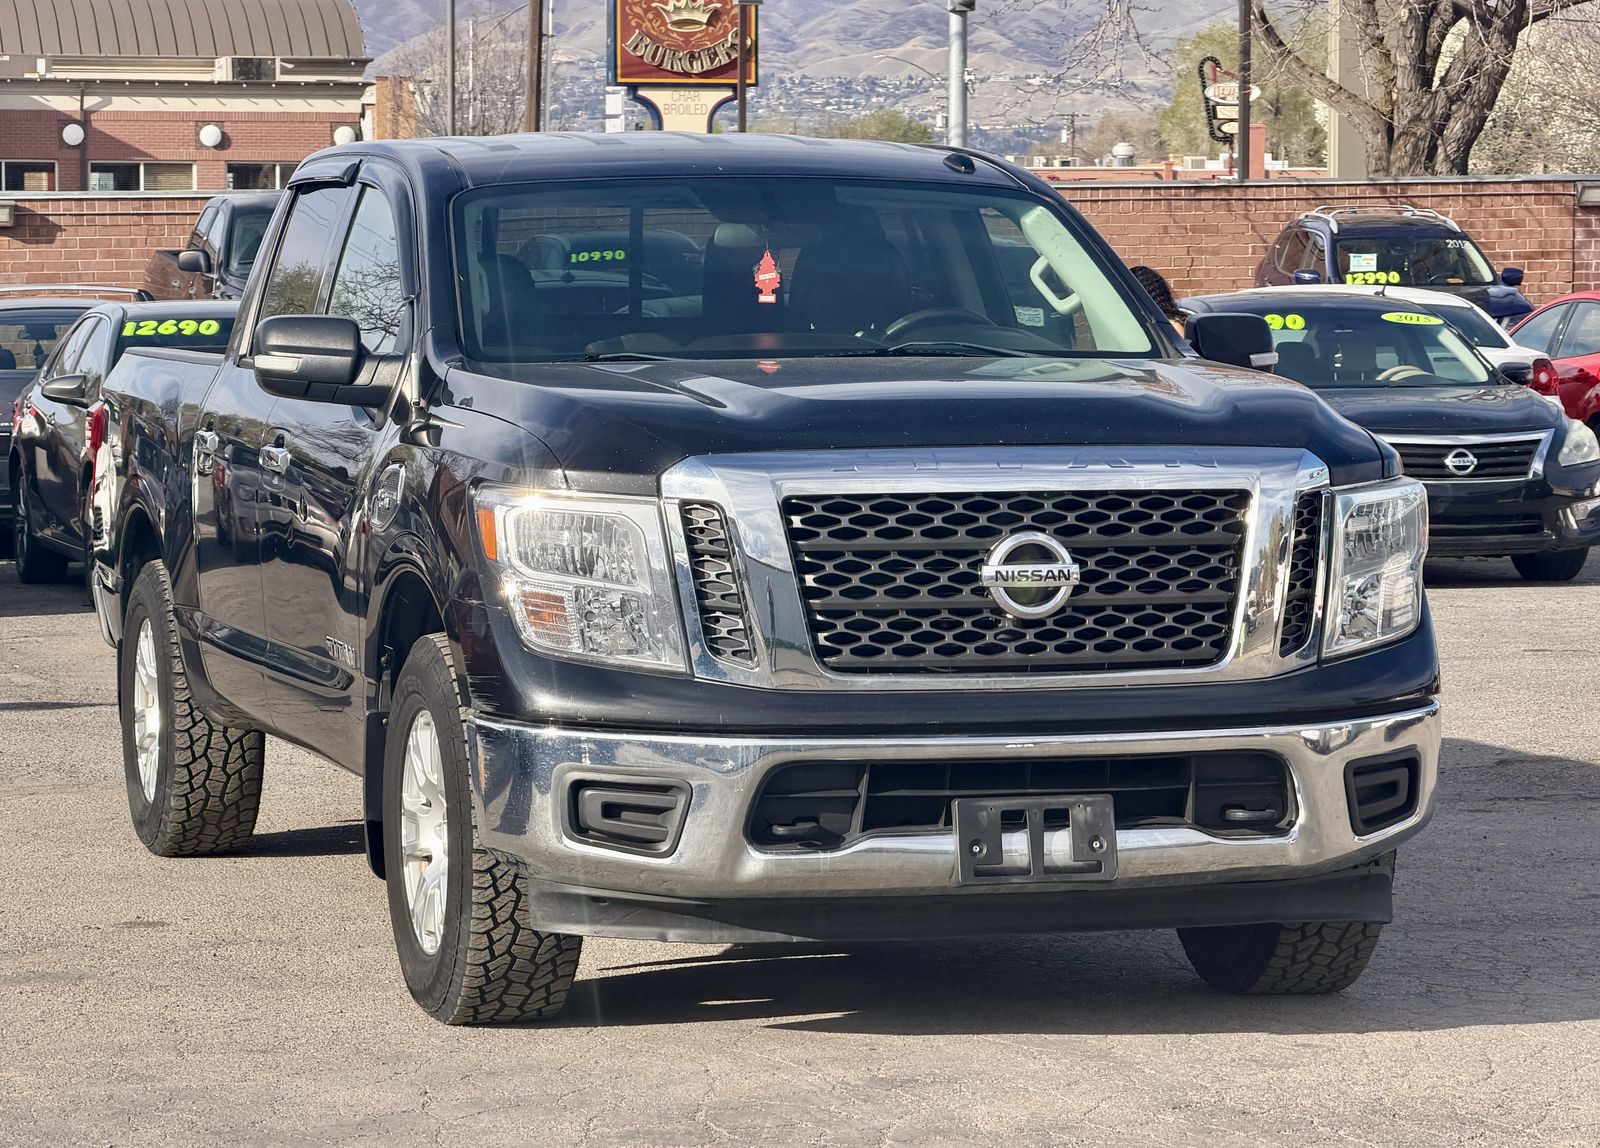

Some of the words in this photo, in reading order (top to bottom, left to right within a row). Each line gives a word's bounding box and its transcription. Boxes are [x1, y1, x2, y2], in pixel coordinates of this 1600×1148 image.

[671, 90, 701, 101] CHAR
[663, 104, 708, 116] BROILED
[570, 249, 625, 263] 10990
[1345, 271, 1400, 285] 12990
[1395, 314, 1431, 323] 2015
[122, 319, 219, 336] 12690
[994, 568, 1071, 582] NISSAN
